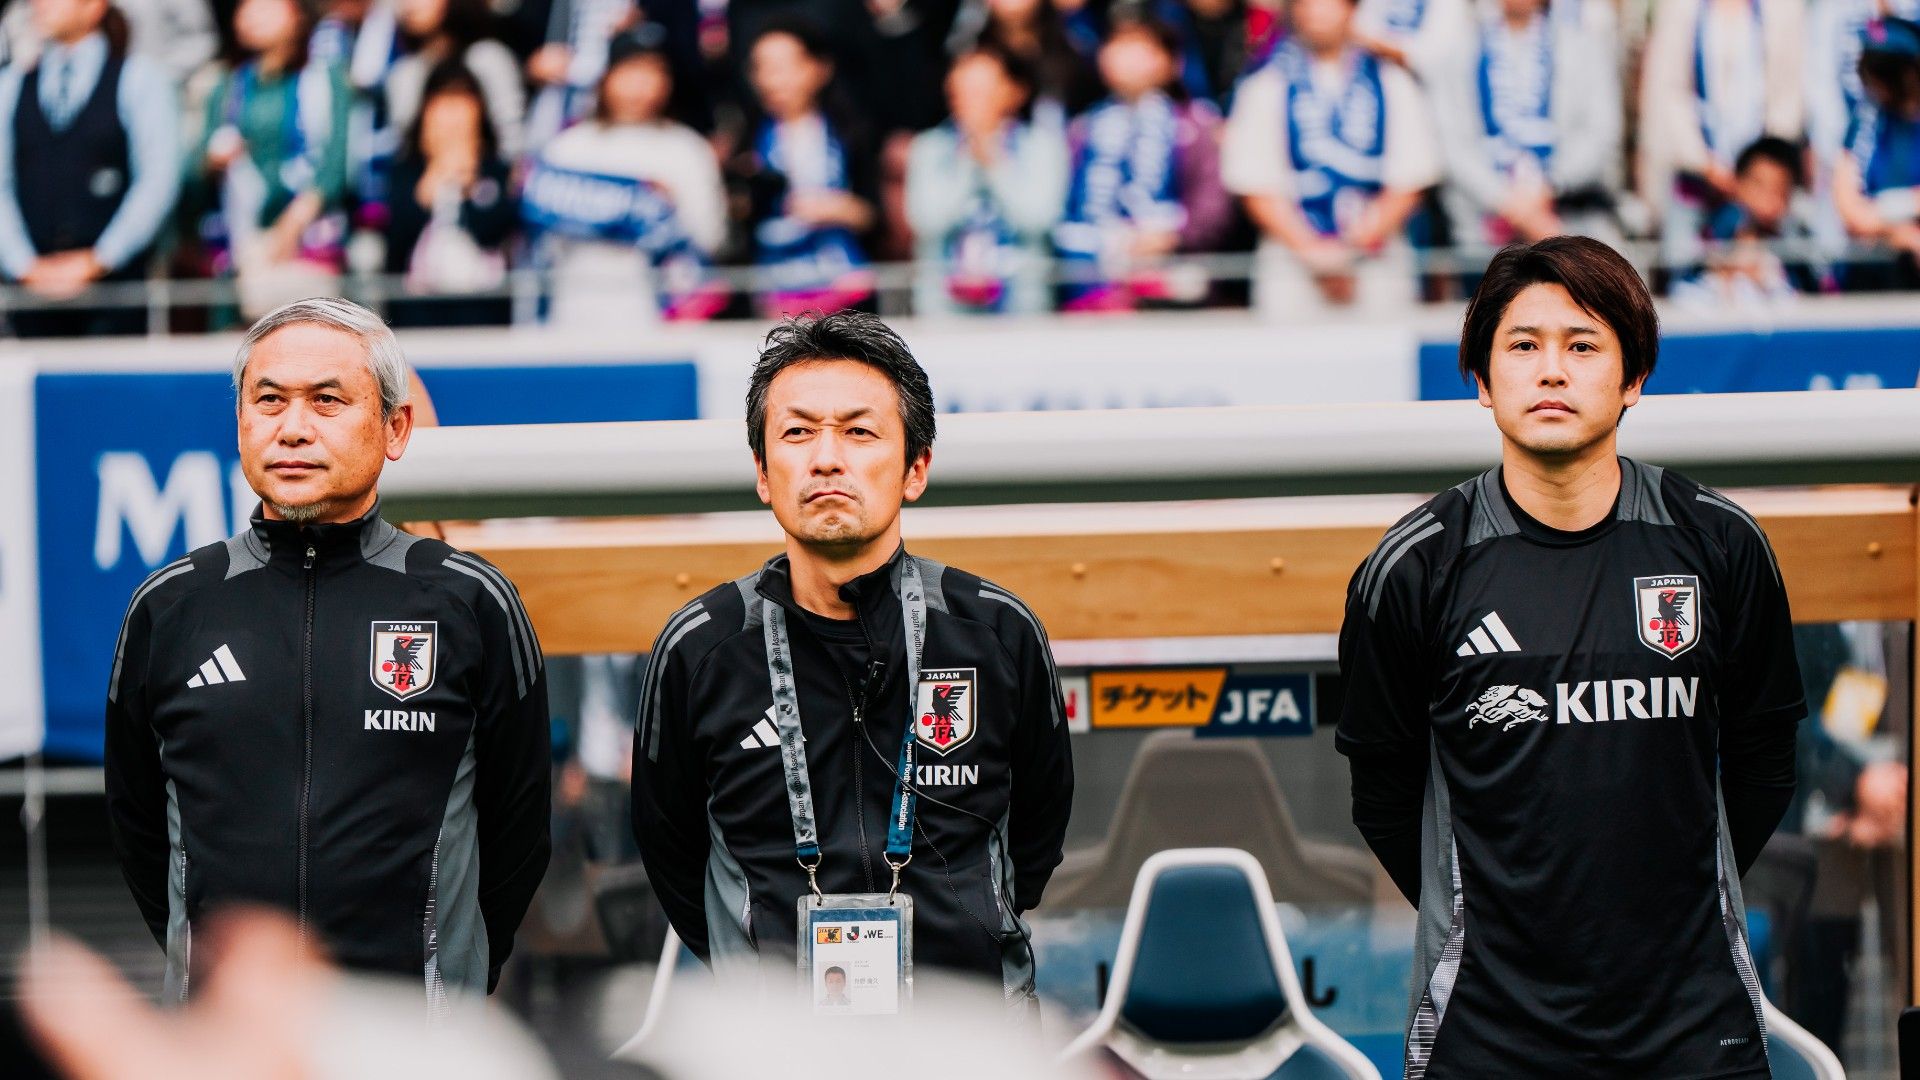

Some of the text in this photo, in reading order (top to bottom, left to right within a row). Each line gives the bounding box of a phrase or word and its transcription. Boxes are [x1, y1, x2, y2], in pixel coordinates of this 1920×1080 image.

[1651, 578, 1684, 587] JAPAN
[388, 624, 421, 632] JAPAN
[769, 608, 780, 647] Association
[1657, 631, 1684, 644] JFA
[388, 673, 417, 687] JFA
[926, 672, 960, 680] JAPAN
[1102, 683, 1209, 713] チケット
[1219, 688, 1303, 726] JFA
[1555, 676, 1700, 725] KIRIN
[364, 709, 436, 733] KIRIN
[928, 726, 958, 740] JFA
[903, 763, 913, 791] Footbl
[898, 791, 910, 831] Association
